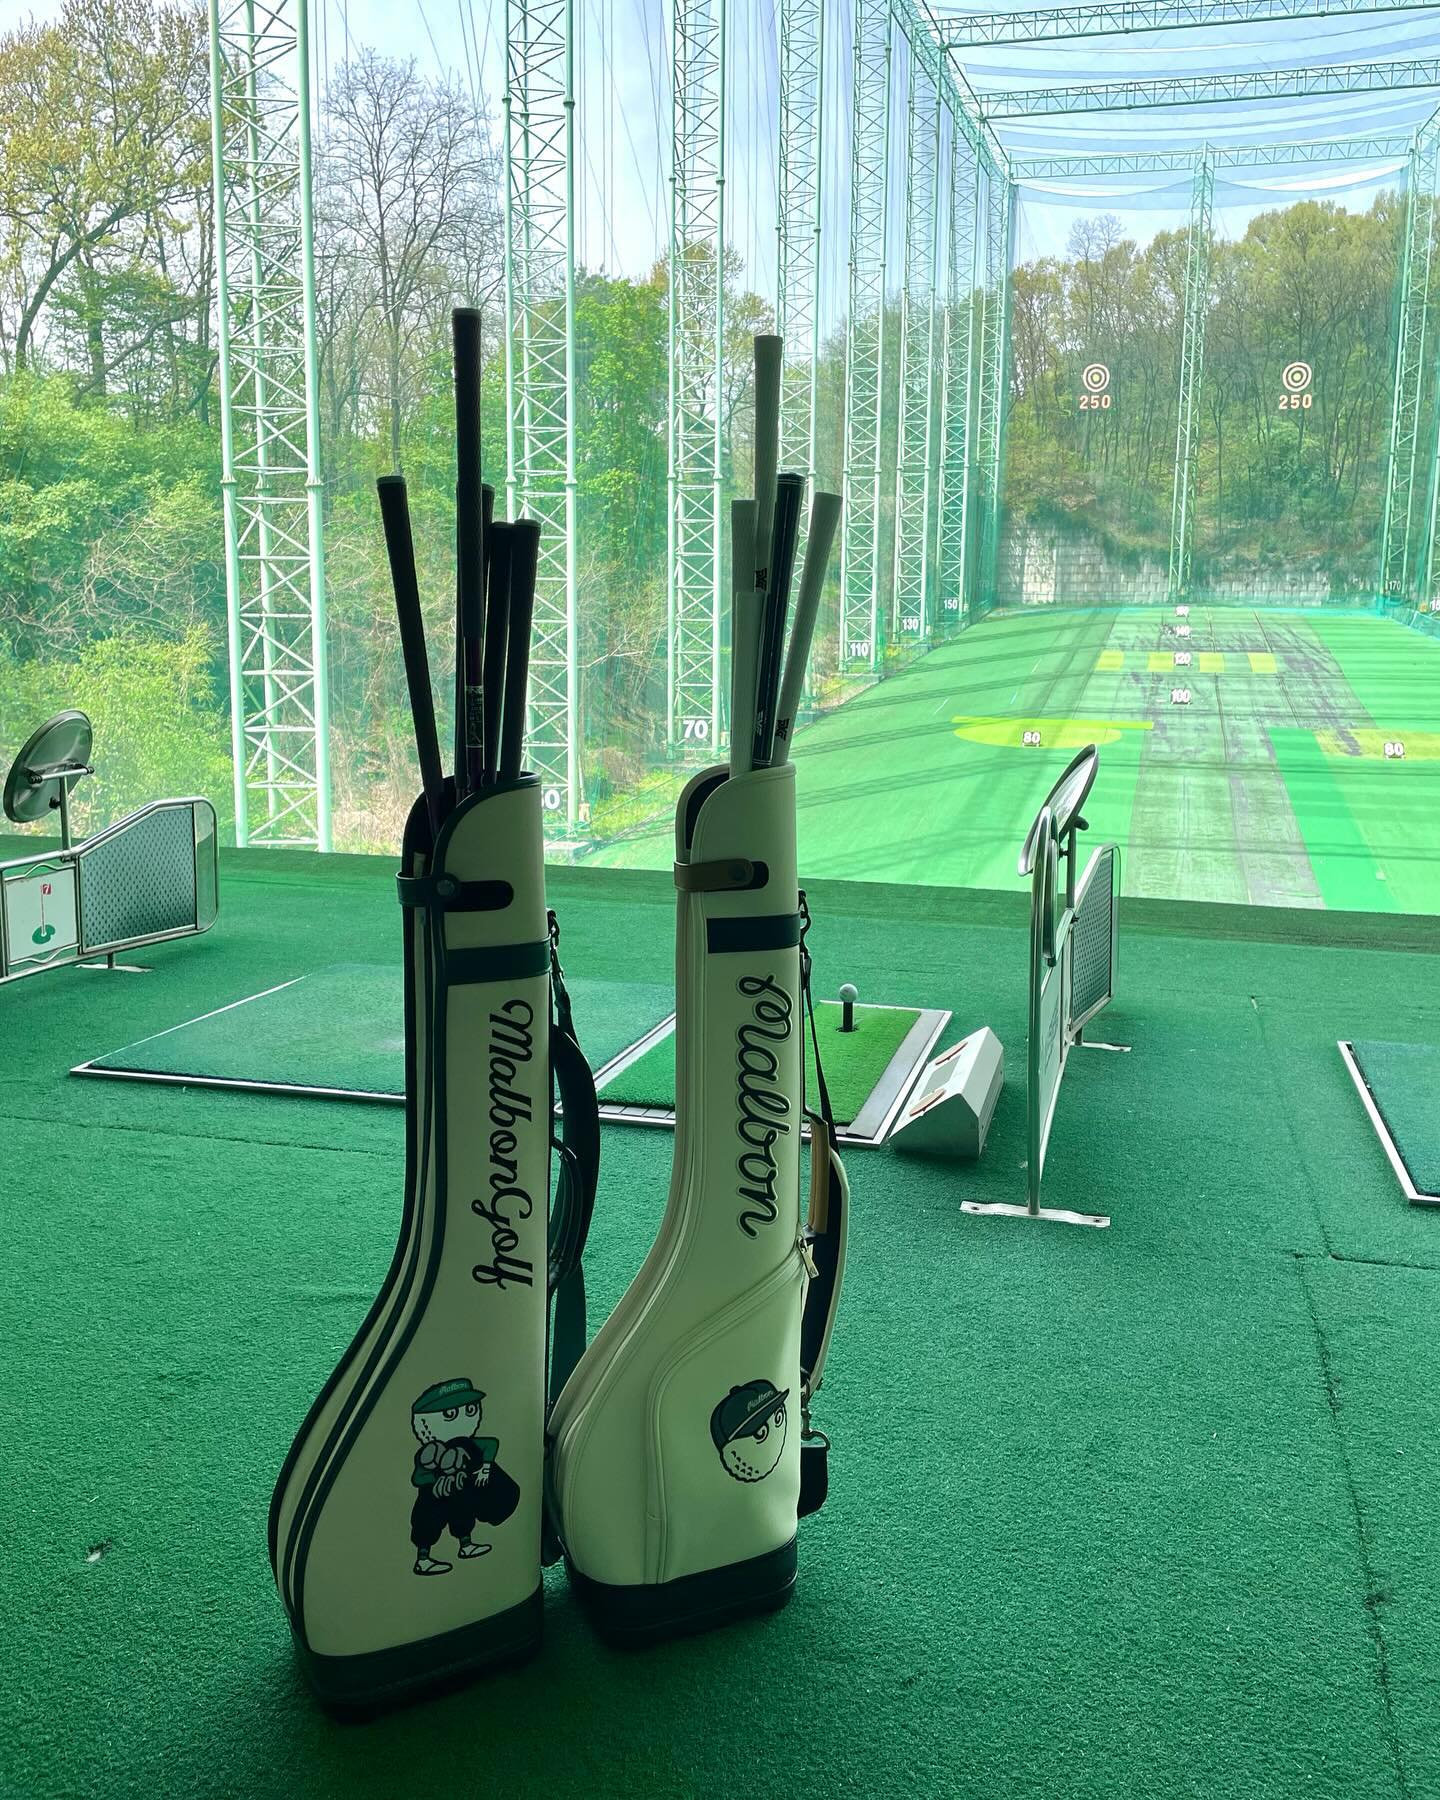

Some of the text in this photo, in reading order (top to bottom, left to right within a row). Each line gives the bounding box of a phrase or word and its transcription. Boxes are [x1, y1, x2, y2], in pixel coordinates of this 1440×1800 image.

[1079, 394, 1111, 409] 250
[1279, 393, 1312, 410] 250
[1388, 580, 1402, 591] 170
[943, 599, 958, 610] 150
[902, 618, 918, 630] 130
[849, 642, 869, 656] 110
[1174, 652, 1191, 665] 120
[1171, 689, 1191, 703] 100
[682, 720, 708, 739] 70
[1023, 731, 1041, 744] 80
[1384, 743, 1404, 756] 80
[541, 789, 560, 809] 0
[737, 974, 793, 1240] Malbon
